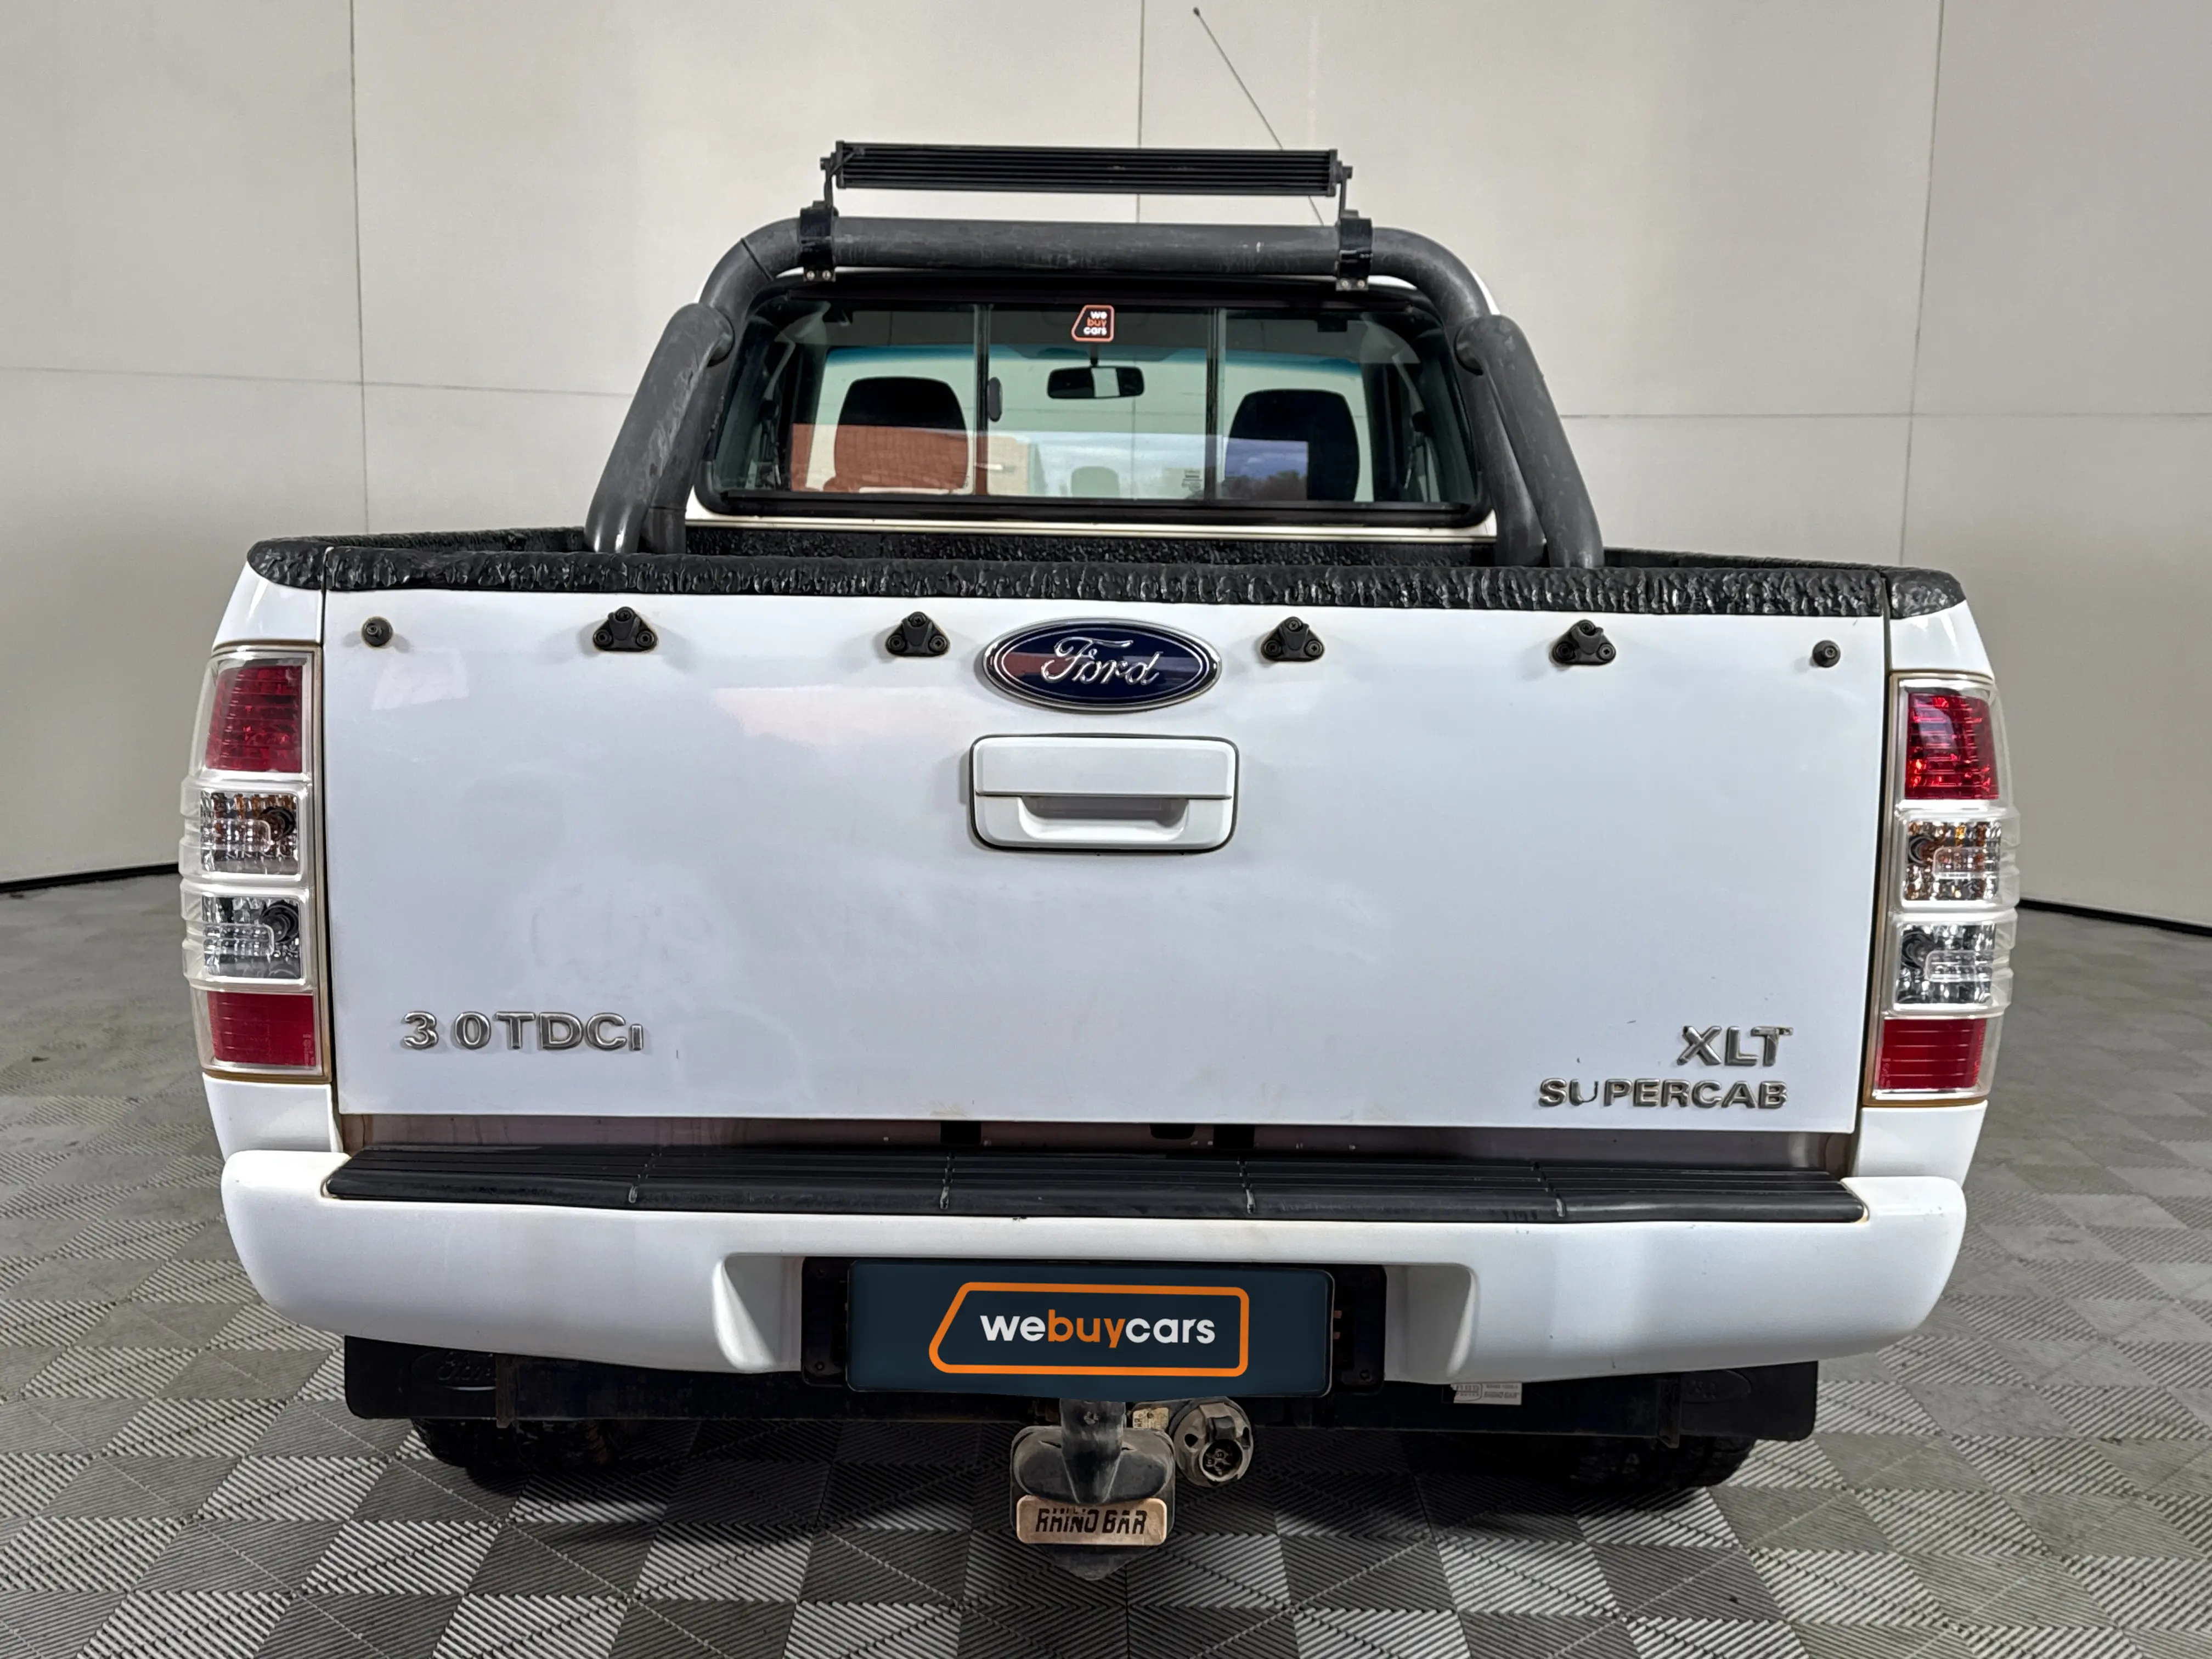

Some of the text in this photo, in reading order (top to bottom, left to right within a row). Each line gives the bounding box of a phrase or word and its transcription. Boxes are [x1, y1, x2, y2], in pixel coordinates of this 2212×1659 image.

[1087, 318, 1107, 326] buy
[1041, 636, 1163, 686] Ford
[1677, 1025, 1794, 1066] XLT
[1538, 1077, 1788, 1109] SUPERCAB
[980, 1309, 1215, 1348] webuycars
[1035, 1508, 1147, 1534] RHINO BAR
